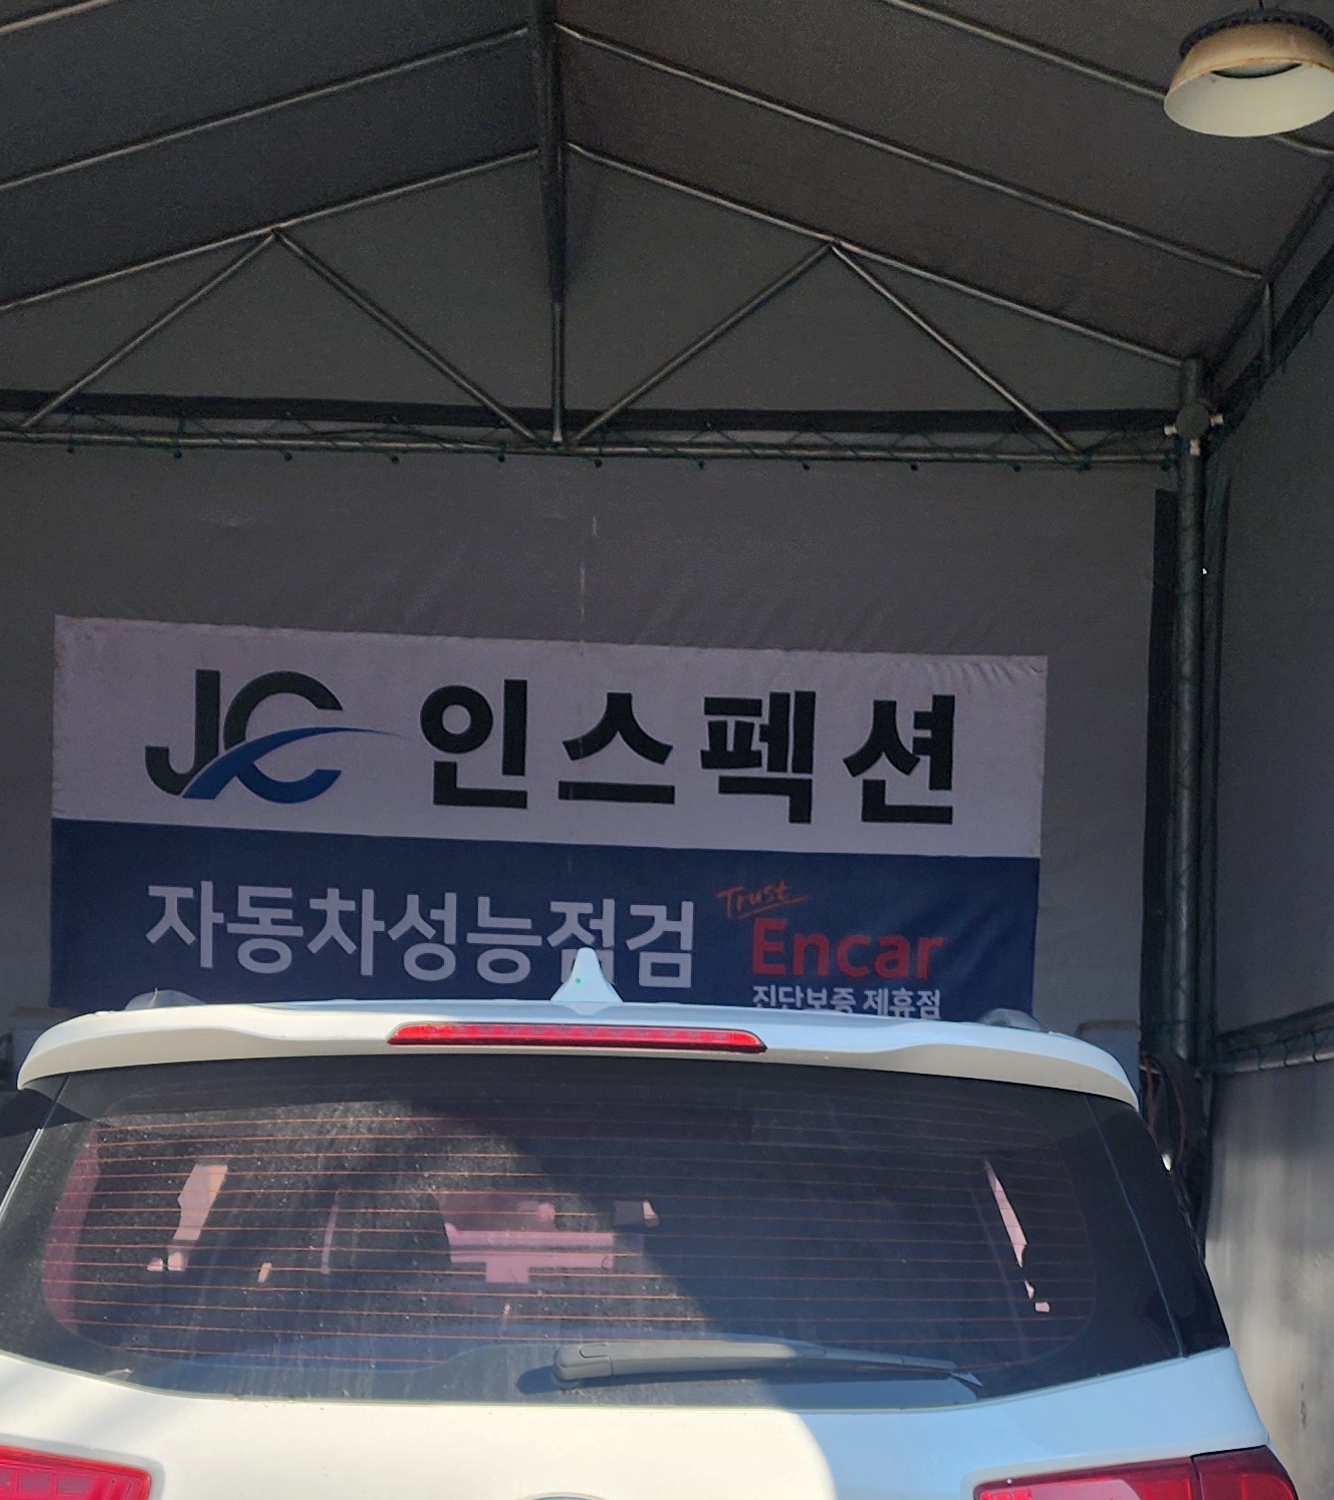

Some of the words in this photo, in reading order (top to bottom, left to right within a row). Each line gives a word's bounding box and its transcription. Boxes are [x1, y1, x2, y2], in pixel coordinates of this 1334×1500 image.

[145, 668, 345, 804] JC
[419, 678, 956, 825] 인스펙션
[717, 880, 793, 920] Trust
[145, 880, 694, 989] 자동차성능점검
[751, 917, 946, 981] Encar
[862, 986, 942, 1020] 제휴점
